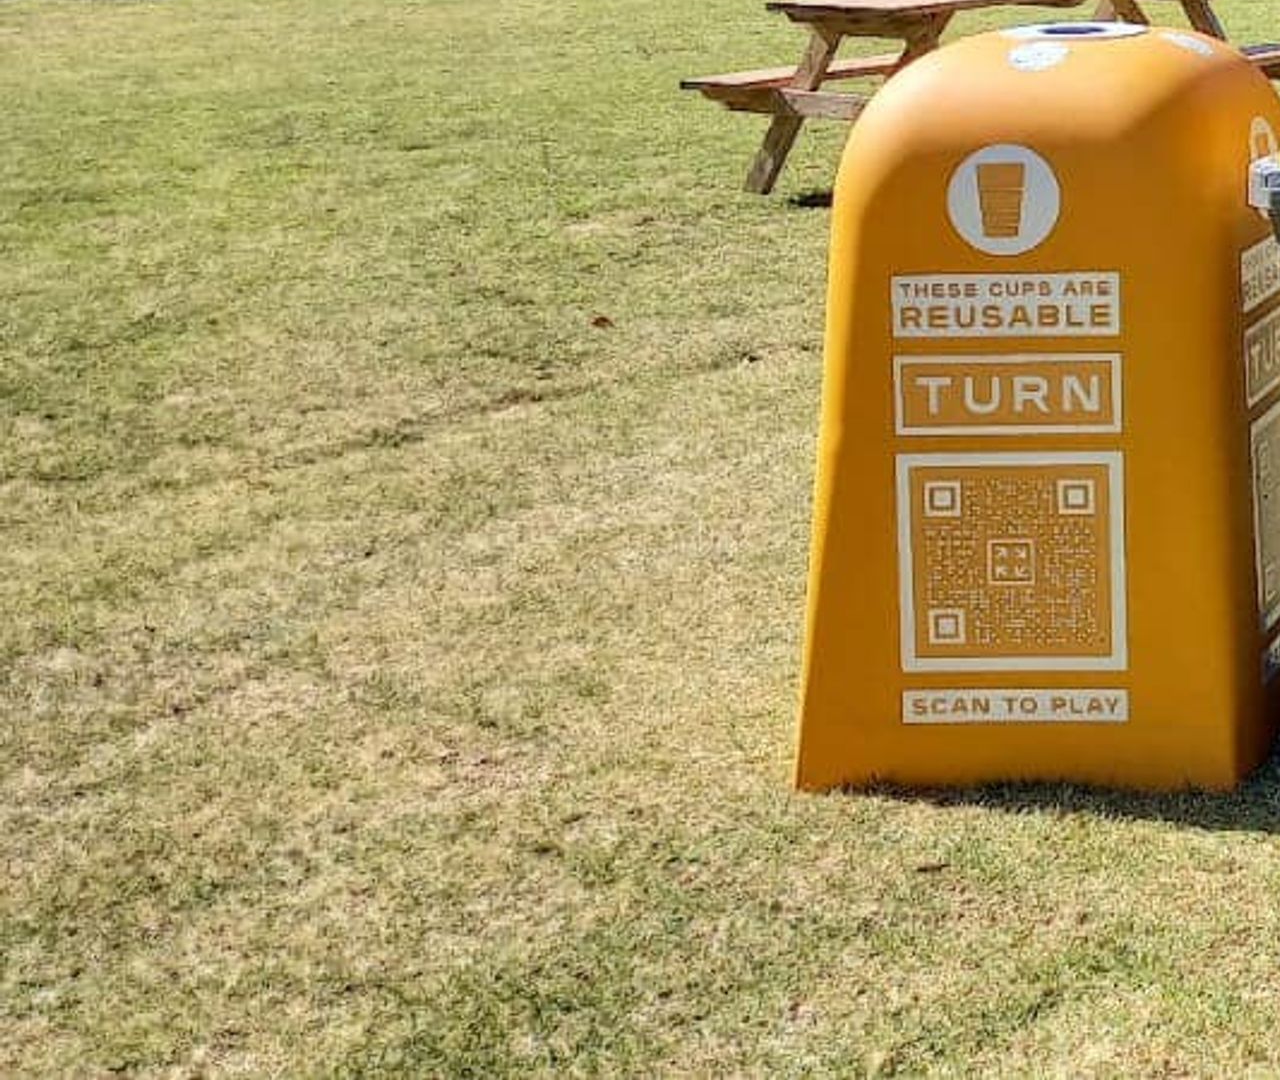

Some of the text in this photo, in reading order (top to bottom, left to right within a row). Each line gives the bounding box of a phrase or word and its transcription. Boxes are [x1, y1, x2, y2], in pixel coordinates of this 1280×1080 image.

[900, 280, 1112, 298] THESE CUPS ARE
[900, 304, 1111, 329] REUSABLE
[915, 375, 1100, 415] TURN
[912, 696, 1119, 716] SCAN TO PLAY
